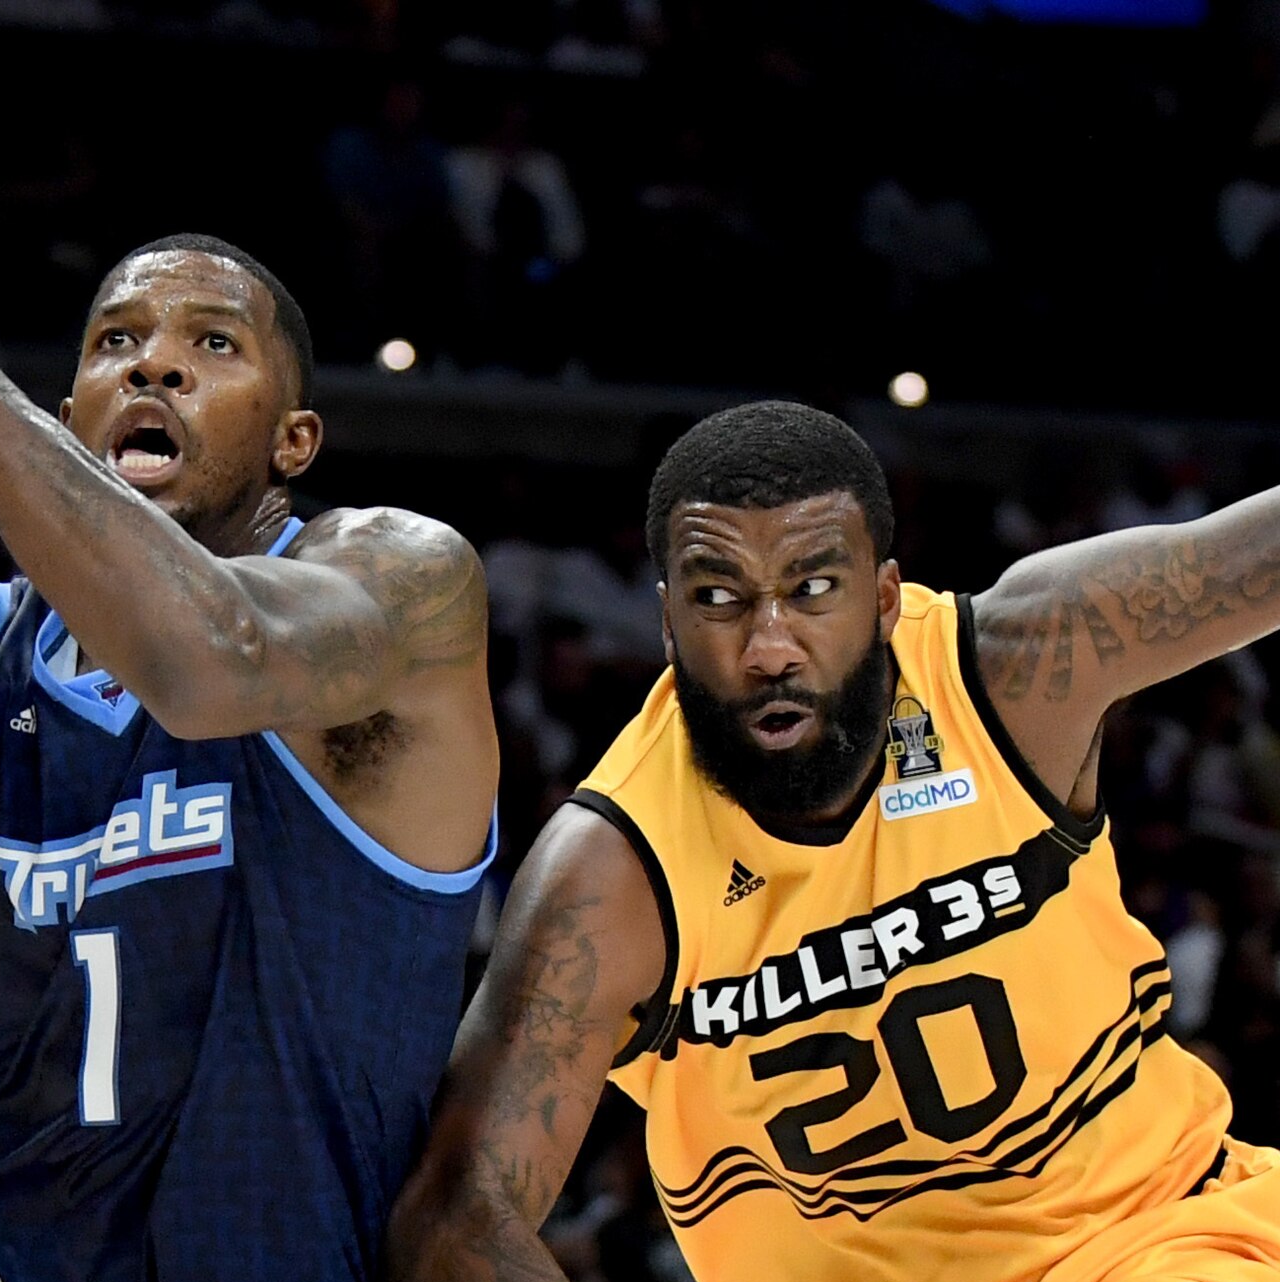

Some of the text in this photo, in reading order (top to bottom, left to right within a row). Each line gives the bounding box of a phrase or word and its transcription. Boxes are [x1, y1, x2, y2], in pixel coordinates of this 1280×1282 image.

[885, 779, 970, 812] cbdMD
[723, 876, 766, 906] adidas
[72, 930, 120, 1124] 1
[692, 907, 925, 1036] KILLER
[749, 972, 1028, 1175] 20
